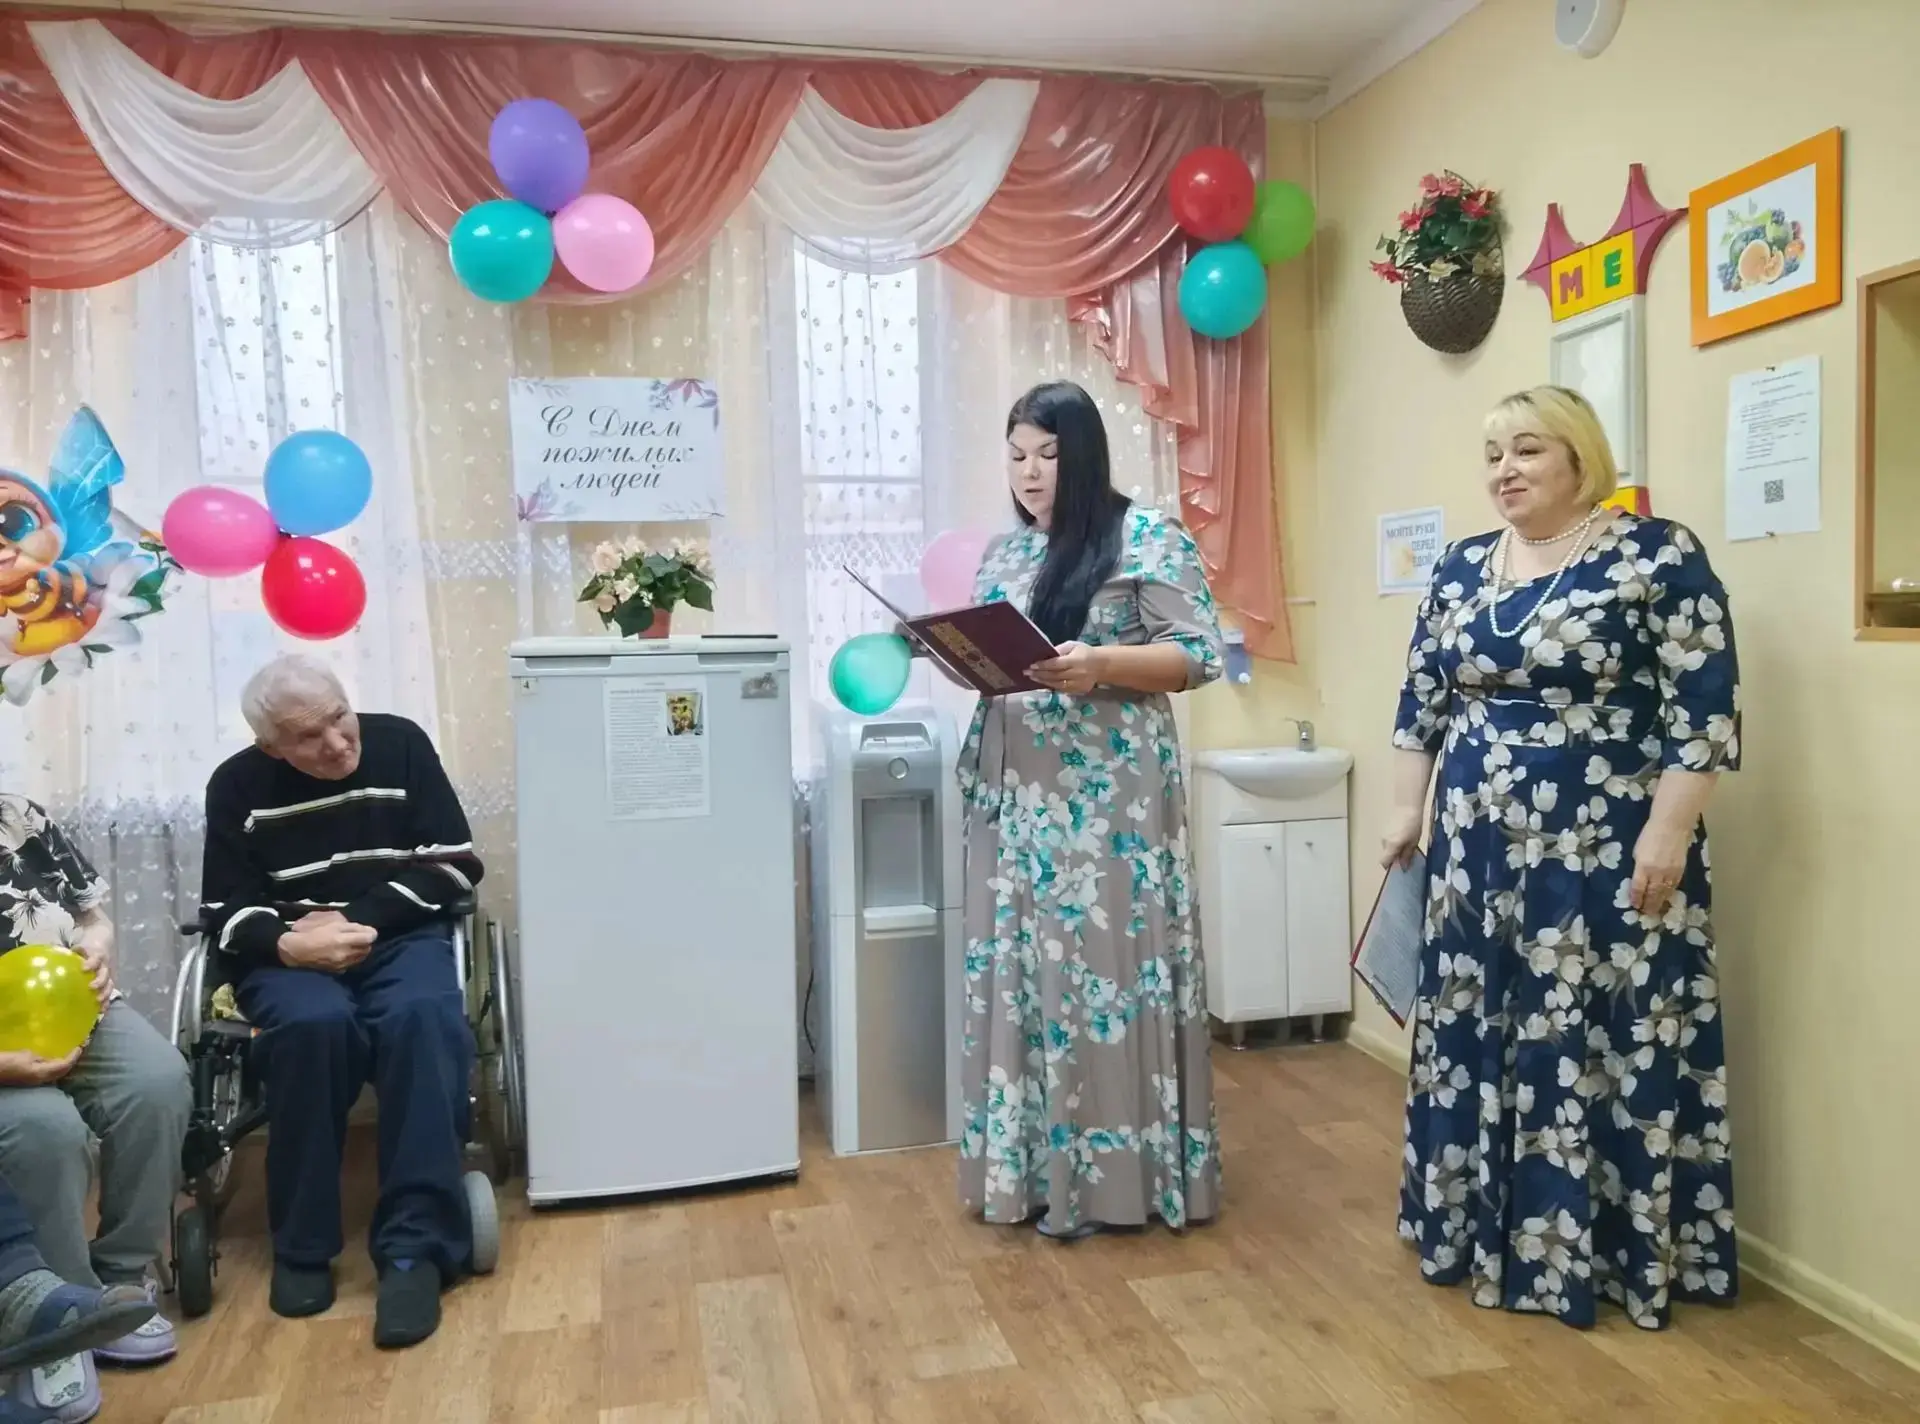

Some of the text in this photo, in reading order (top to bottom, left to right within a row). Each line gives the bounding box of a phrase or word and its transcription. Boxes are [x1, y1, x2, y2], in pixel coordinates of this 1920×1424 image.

[541, 405, 682, 437] С Днем
[542, 446, 694, 464] пожилых
[560, 463, 663, 497] людей
